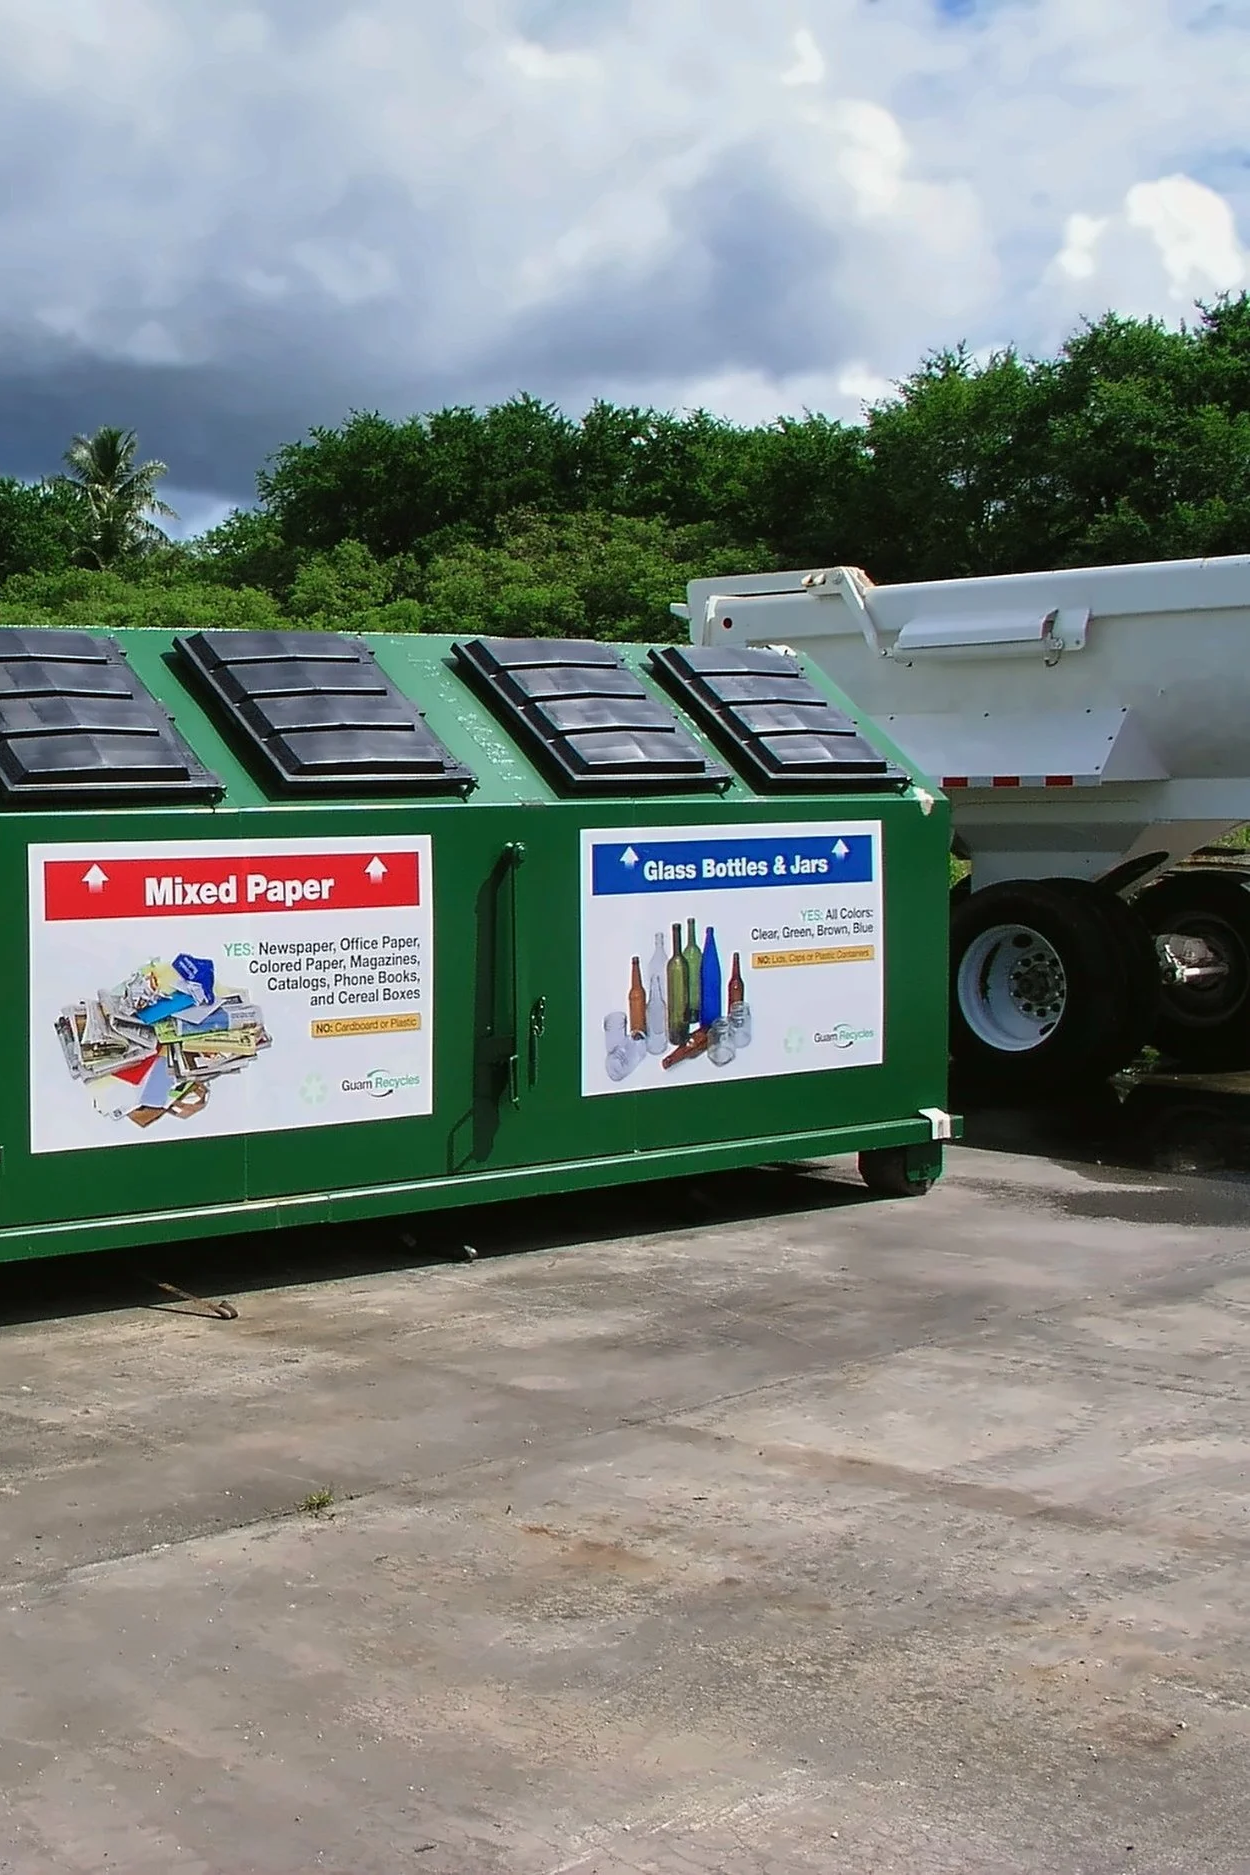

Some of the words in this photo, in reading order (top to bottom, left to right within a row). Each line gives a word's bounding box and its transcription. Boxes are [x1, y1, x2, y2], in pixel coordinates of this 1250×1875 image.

[643, 860, 696, 881] Glass
[702, 857, 768, 878] Bottles
[773, 855, 787, 875] &
[790, 855, 829, 874] Jars
[144, 875, 238, 906] Mixed
[246, 873, 335, 907] Paper
[825, 908, 838, 920] All
[751, 927, 780, 940] Clear,
[782, 926, 814, 938] Green,
[817, 924, 850, 937] Brown,
[853, 922, 874, 934] Blue
[224, 943, 255, 957] YES:
[258, 941, 336, 959] Newspaper,
[340, 937, 379, 951] Office
[382, 936, 420, 951] Paper,
[249, 959, 301, 974] Colored
[306, 957, 347, 973] Paper,
[350, 953, 420, 970] Magazines,
[267, 975, 330, 992] Catalogs,
[334, 973, 375, 987] Phone
[378, 970, 420, 983] Books,
[310, 993, 335, 1006] and
[338, 989, 379, 1004] Cereal
[382, 988, 421, 1001] Boxes
[316, 1023, 333, 1034] NO:
[335, 1020, 378, 1032] Cardboard
[380, 1020, 389, 1029] or
[390, 1018, 417, 1028] Plastic
[341, 1079, 373, 1092] Guam
[375, 1074, 420, 1090] Recycles
